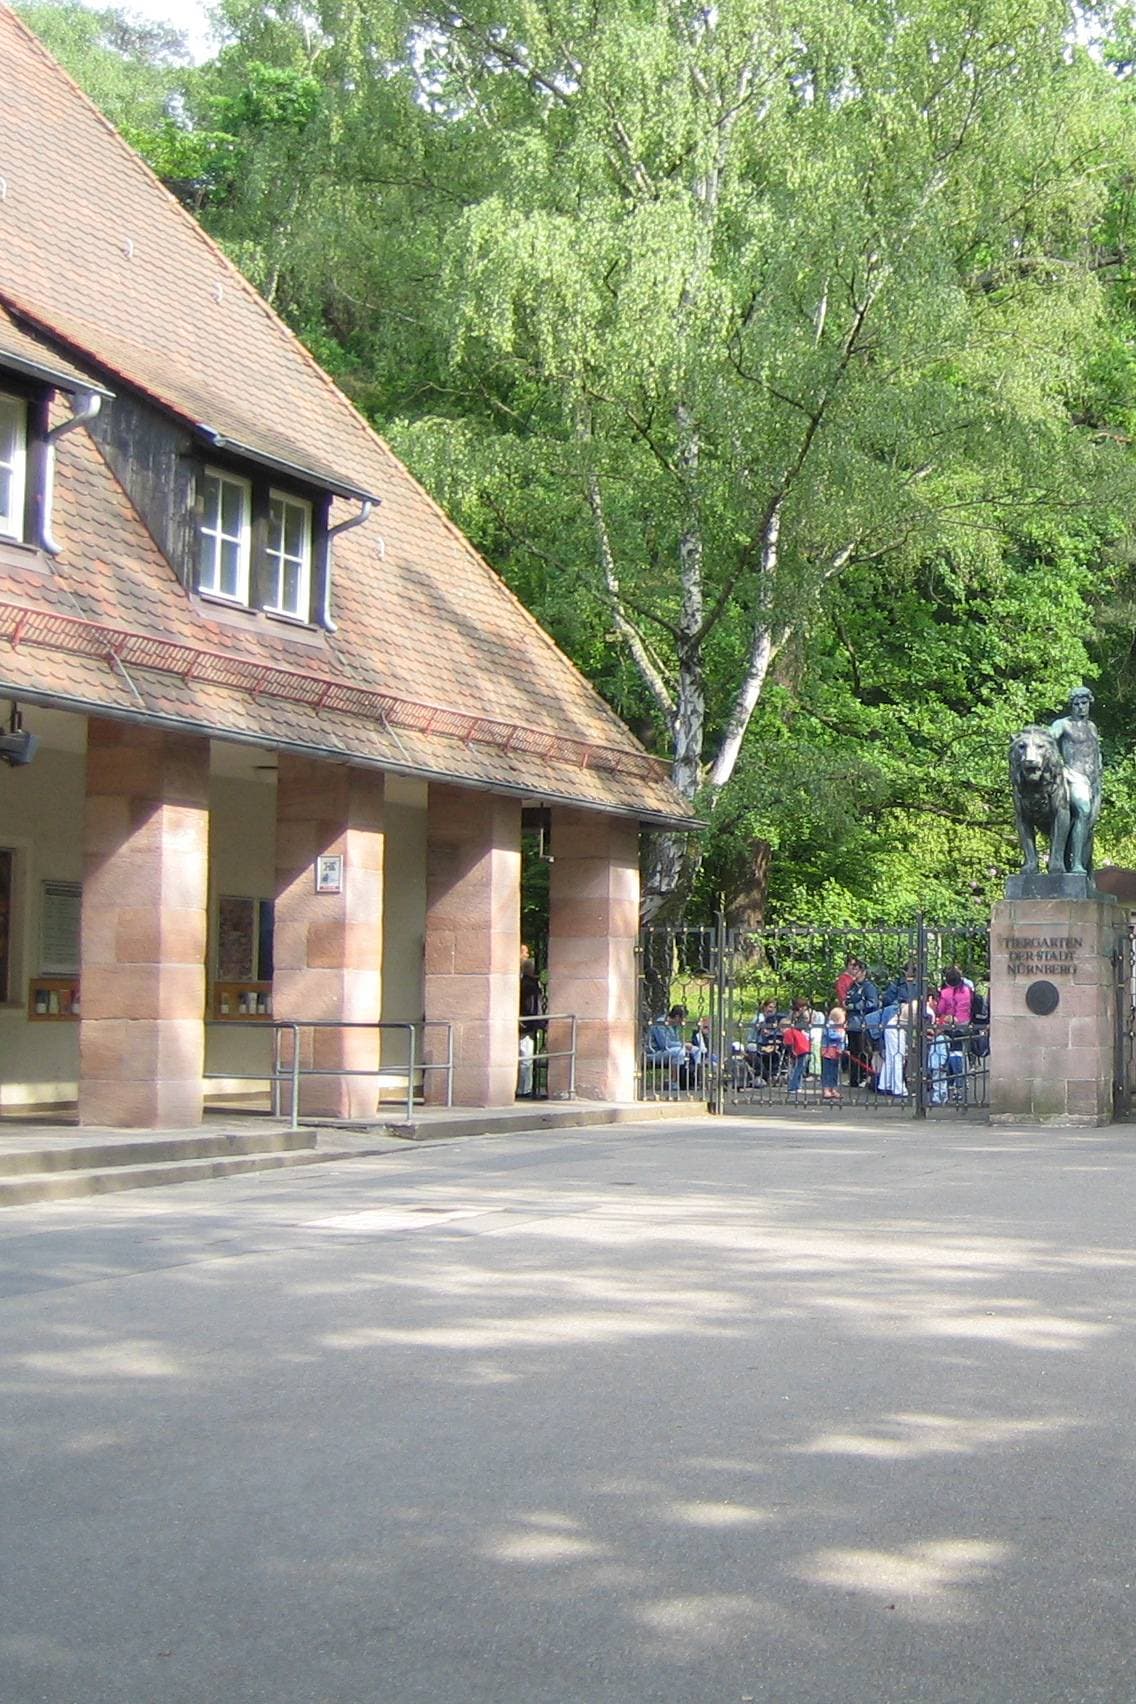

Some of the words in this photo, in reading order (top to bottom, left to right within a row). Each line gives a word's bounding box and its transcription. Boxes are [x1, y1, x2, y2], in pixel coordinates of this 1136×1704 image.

[1003, 937, 1083, 949] TIERGARTEN
[1009, 951, 1034, 961] DER
[1036, 951, 1075, 961] STADT
[1007, 963, 1077, 975] NÜRNBERG
